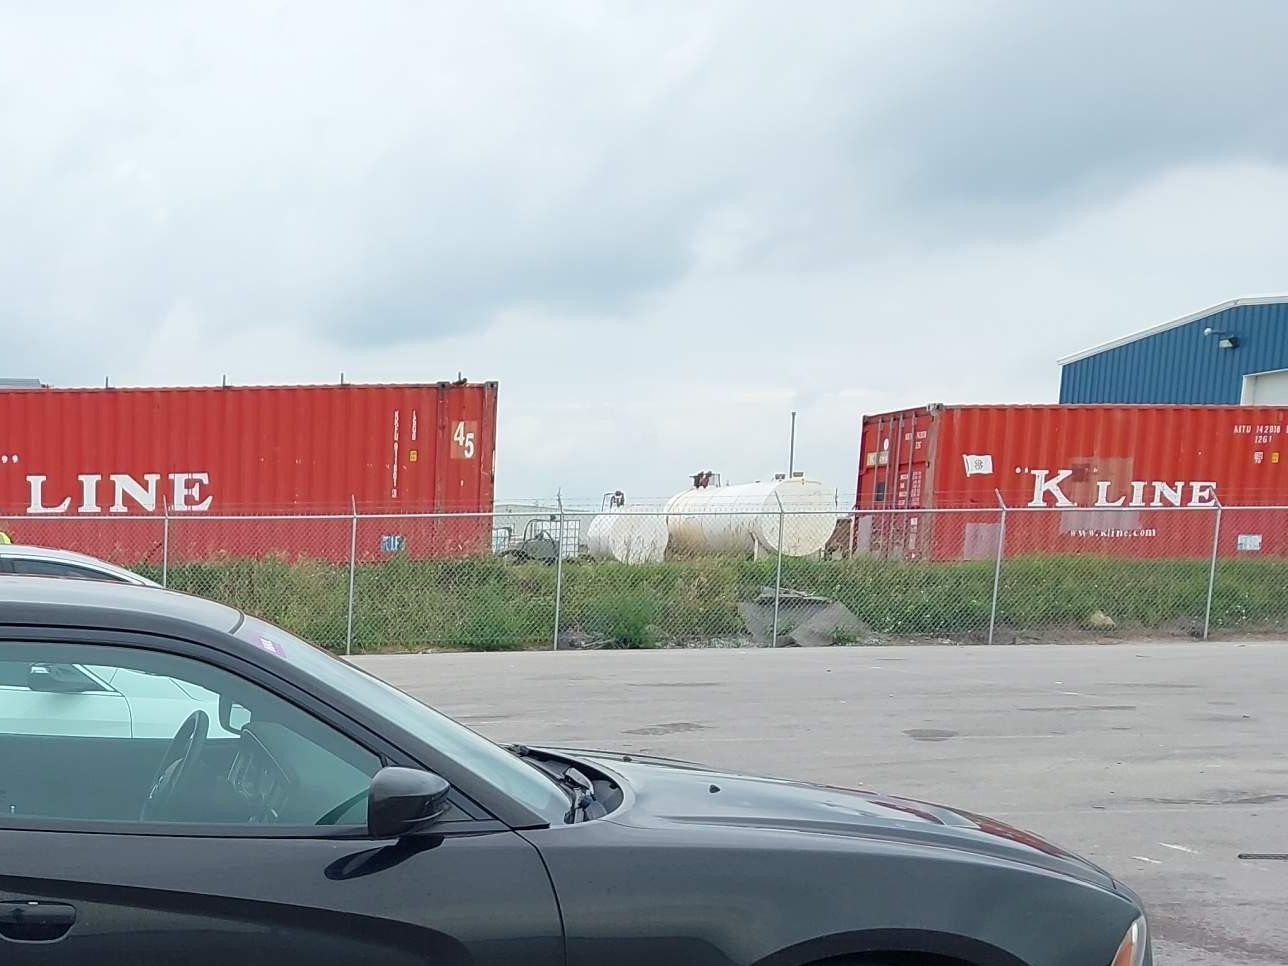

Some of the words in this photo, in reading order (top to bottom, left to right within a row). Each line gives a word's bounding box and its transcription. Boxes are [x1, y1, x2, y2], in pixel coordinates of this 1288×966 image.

[452, 420, 475, 459] 45
[26, 472, 213, 514] LINE
[1094, 481, 1217, 507] LINE
[1070, 527, 1157, 538] www.kline.com
